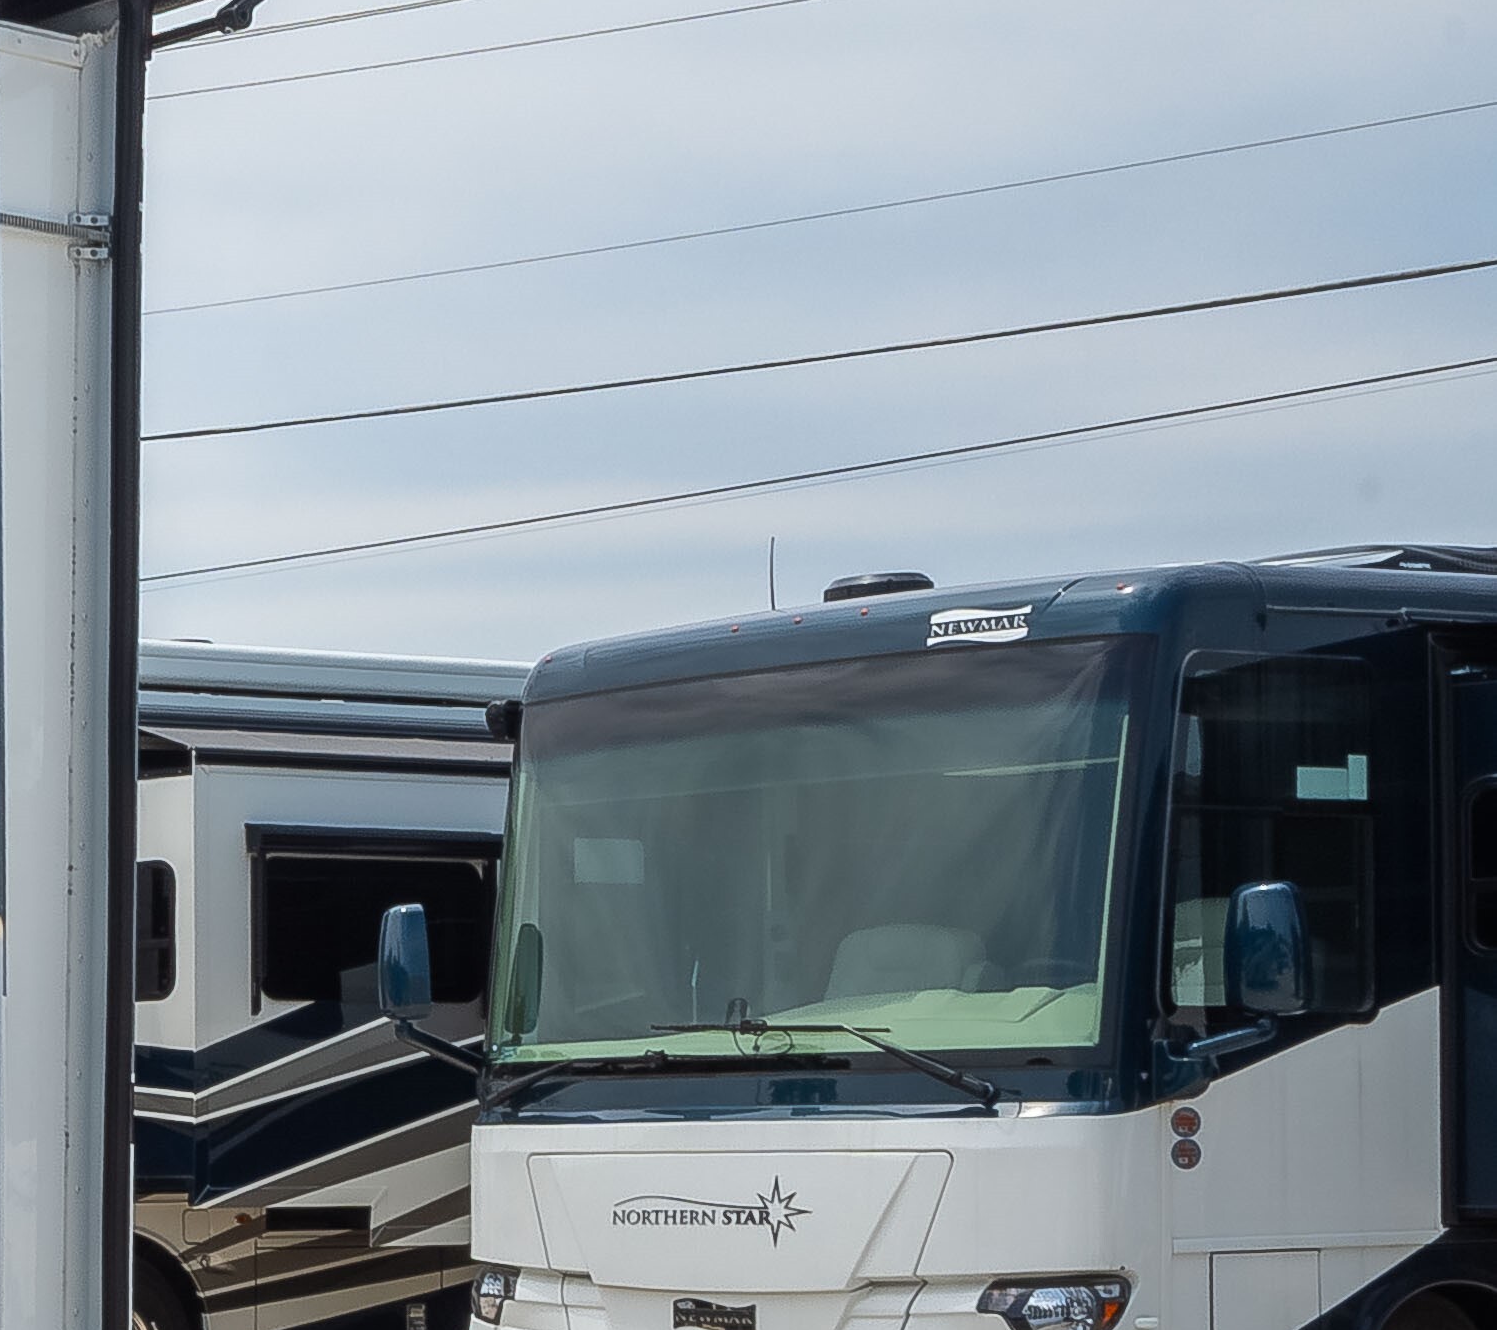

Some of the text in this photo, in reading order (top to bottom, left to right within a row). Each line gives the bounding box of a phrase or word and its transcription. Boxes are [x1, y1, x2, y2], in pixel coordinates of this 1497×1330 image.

[929, 614, 1028, 638] NEWMAR
[612, 1209, 772, 1227] NORTHERN STAR
